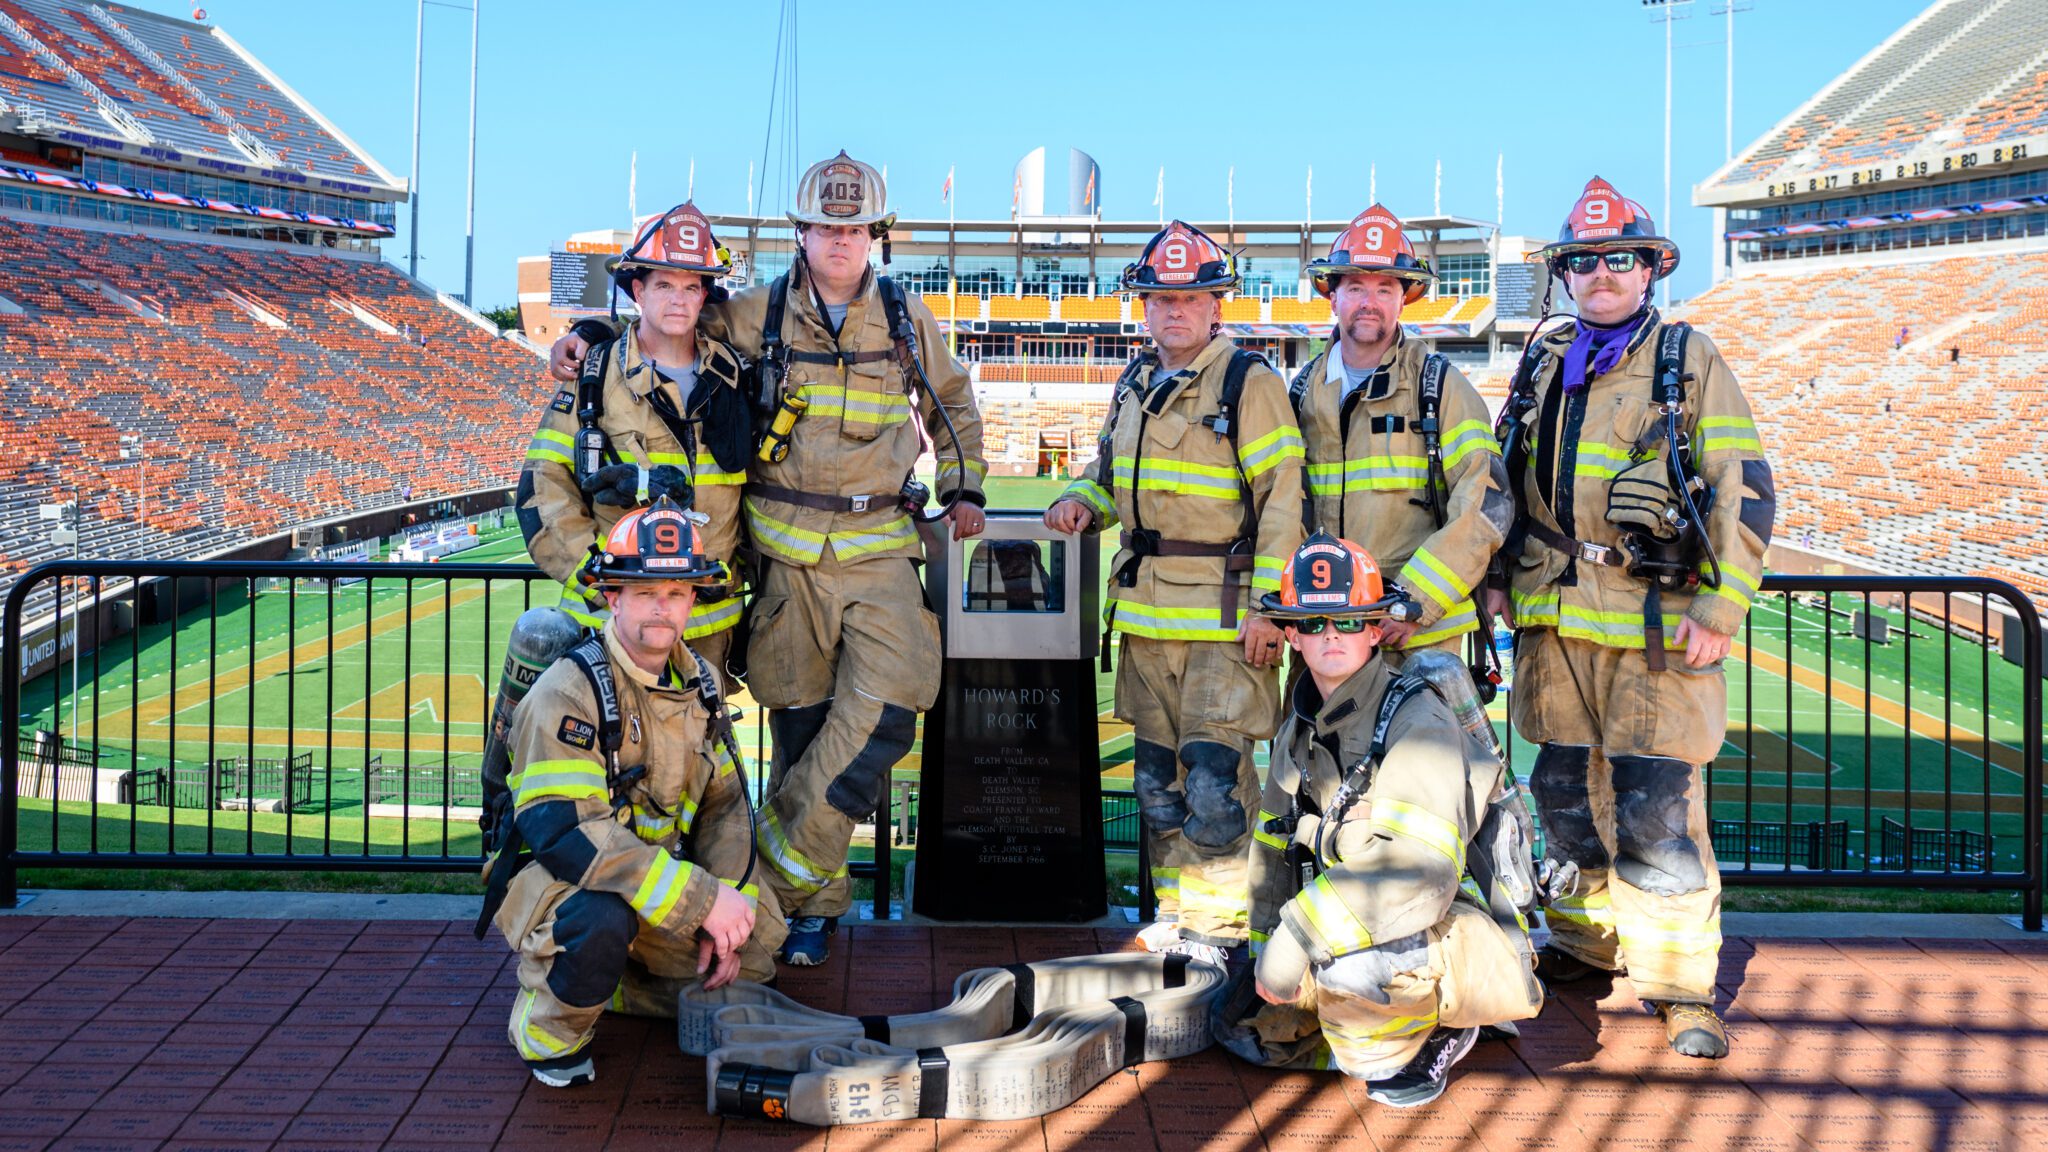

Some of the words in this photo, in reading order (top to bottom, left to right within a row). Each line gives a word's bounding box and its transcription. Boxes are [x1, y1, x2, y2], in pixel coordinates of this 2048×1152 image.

[1943, 152, 1978, 171] 2020
[1993, 144, 2028, 162] 2021
[1852, 168, 1882, 185] 2018
[1896, 161, 1928, 178] 2019
[820, 182, 864, 201] 403
[1768, 181, 1796, 197] 2016
[1809, 175, 1838, 192] 2017
[1584, 200, 1609, 225] 9
[678, 225, 700, 250] 9
[1365, 226, 1383, 251] 9
[1165, 244, 1187, 269] 9
[655, 524, 680, 554] 9
[1312, 560, 1331, 590] 9
[1305, 594, 1319, 602] FIRE
[1328, 593, 1341, 601] EMS
[28, 638, 56, 666] UNITED
[964, 688, 1061, 705] HOWARD'S
[574, 722, 593, 736] LION
[986, 712, 1038, 729] ROCK
[1000, 747, 1023, 755] FROM
[974, 757, 1000, 765] DEATH
[1006, 766, 1018, 775] TO
[982, 776, 1008, 784] DEATH
[963, 806, 992, 814] COACH
[995, 806, 1022, 814] FRANK
[1026, 806, 1060, 814] HOWARD
[958, 825, 996, 833] CLEMSON
[999, 825, 1040, 833] FOOTBALL
[1044, 826, 1065, 834] TEAM
[1001, 845, 1028, 854] JONES
[978, 855, 1023, 864] SEPTEMBER
[1026, 856, 1045, 864] 1966
[1428, 1038, 1458, 1082] HOKA
[848, 1082, 872, 1118] 343
[881, 1074, 900, 1118] FDNY
